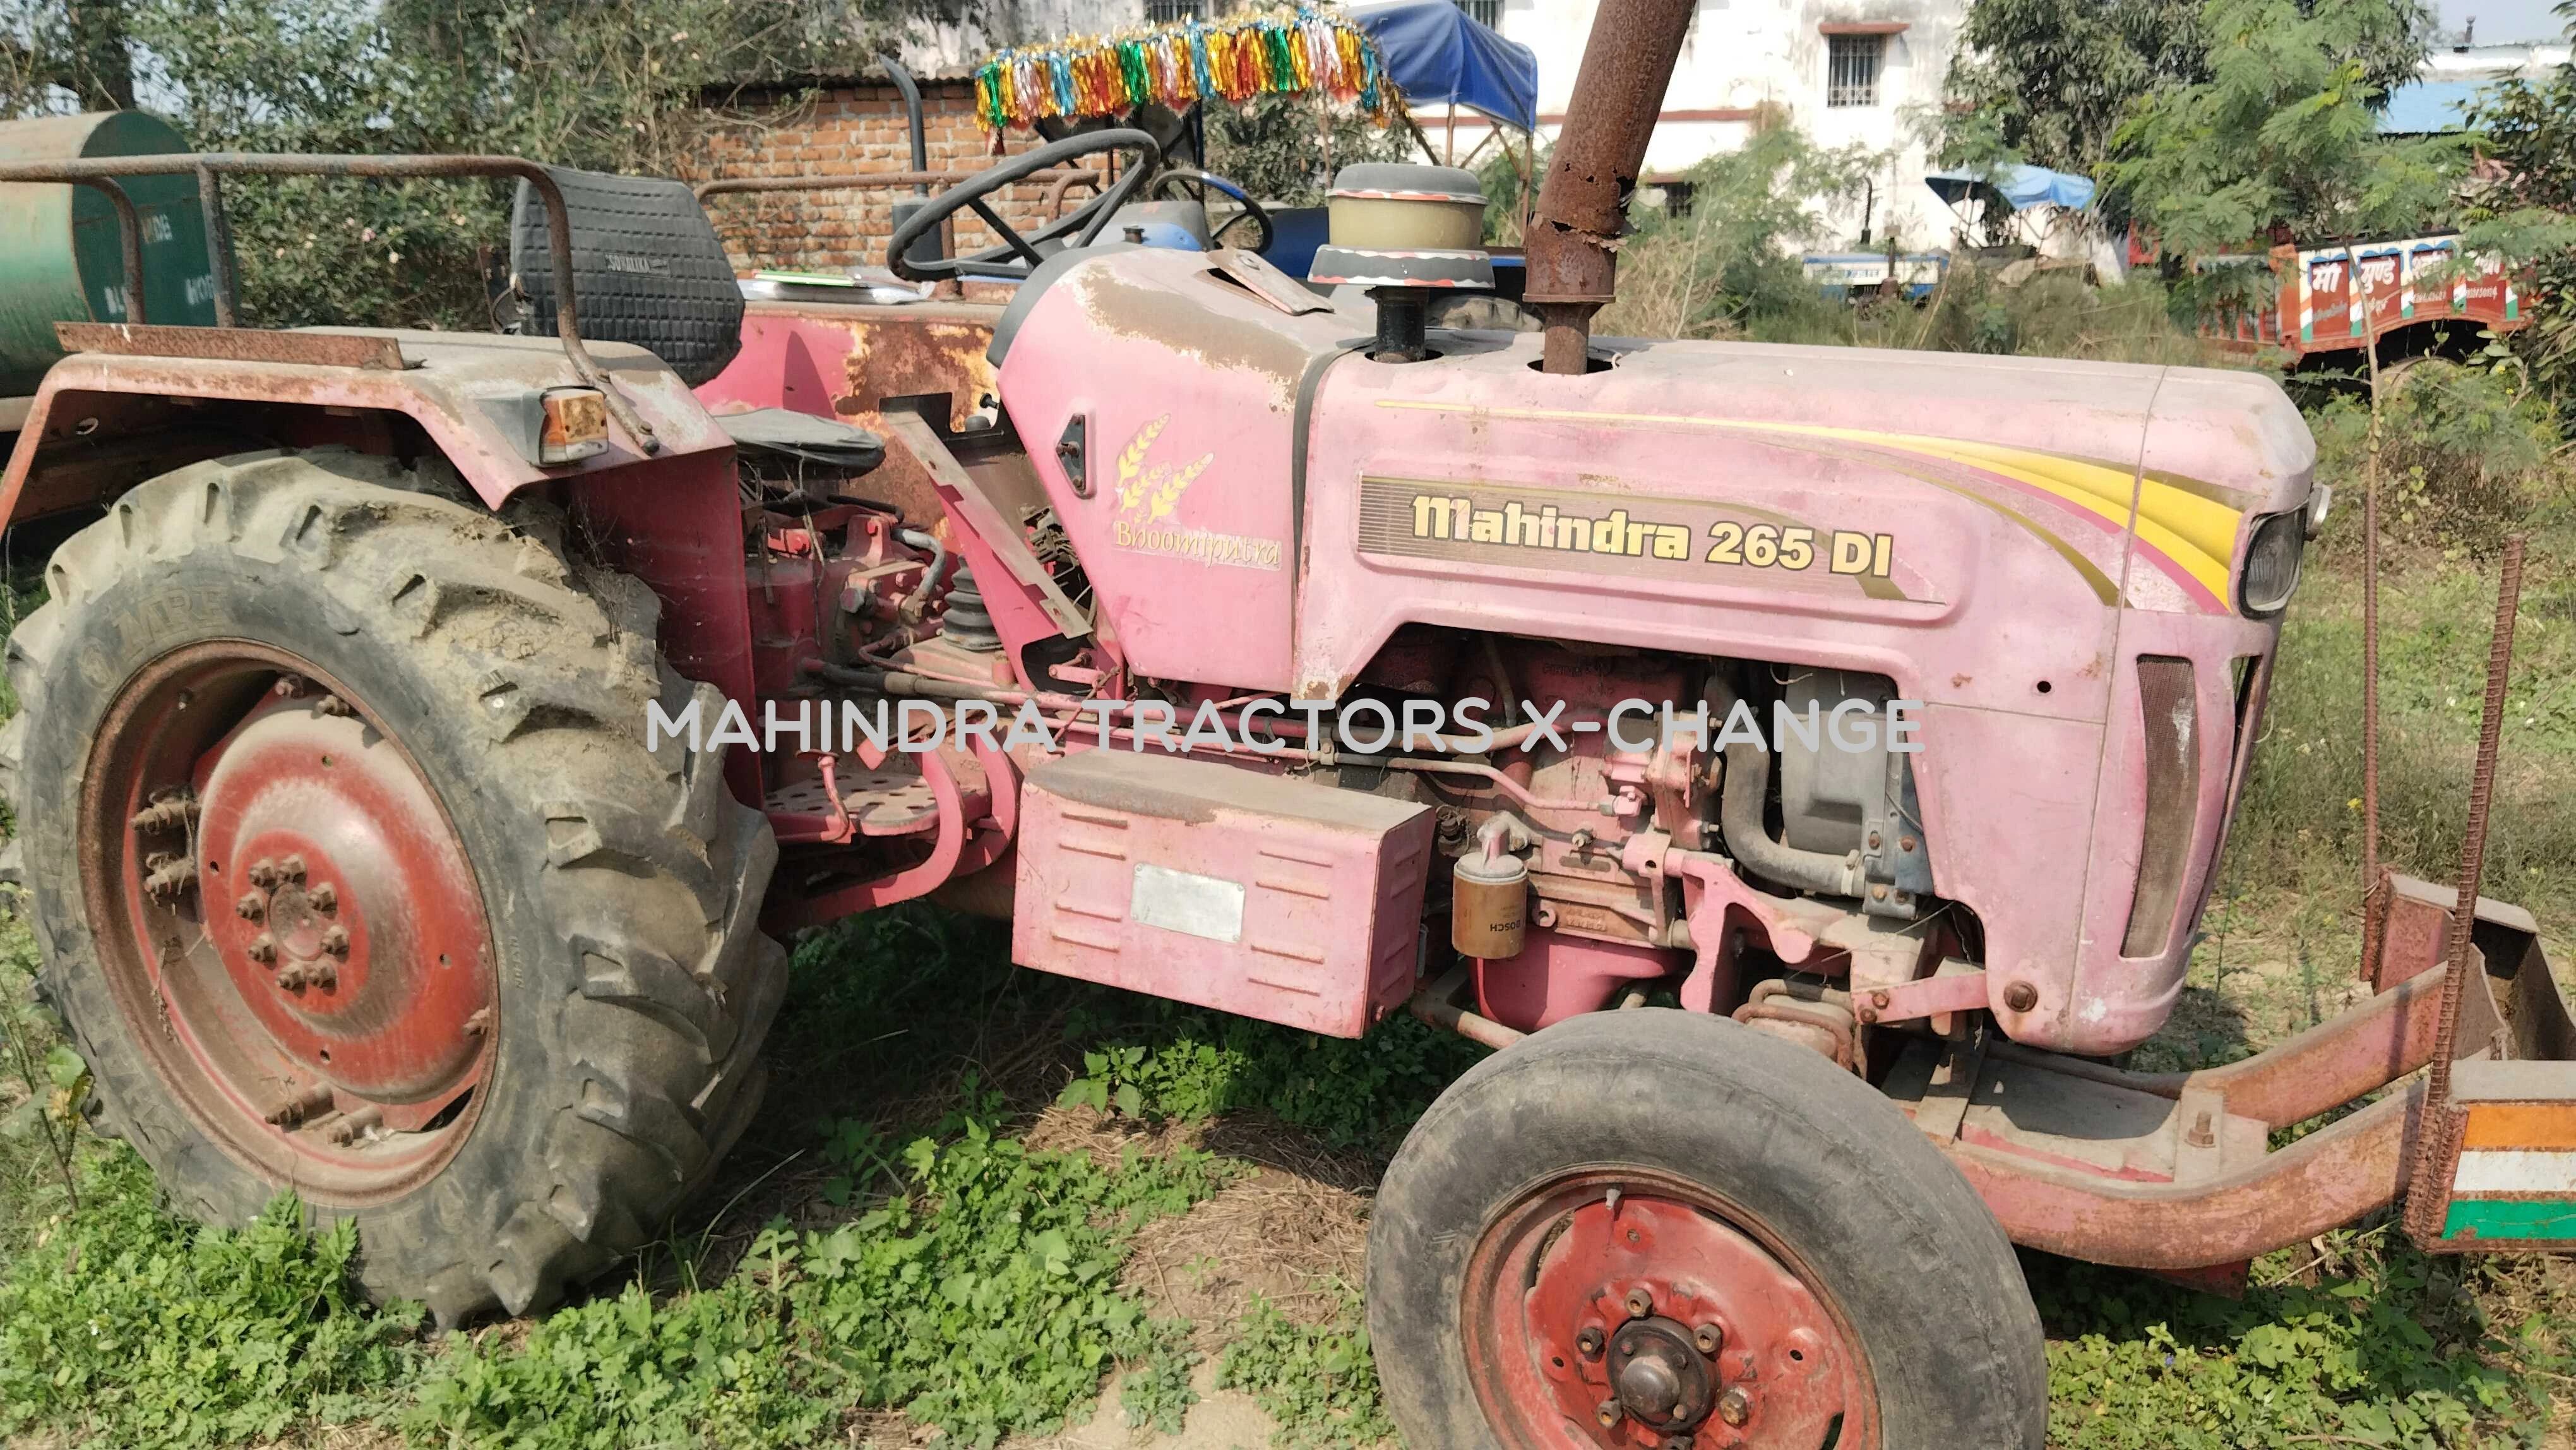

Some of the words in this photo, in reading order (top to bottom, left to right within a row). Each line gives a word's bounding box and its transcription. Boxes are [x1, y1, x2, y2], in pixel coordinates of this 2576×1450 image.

[1410, 495, 1691, 561] Mahindra
[1705, 520, 1815, 571] 265
[1829, 529, 1893, 578] DI
[1489, 919, 1521, 932] BOSCH
